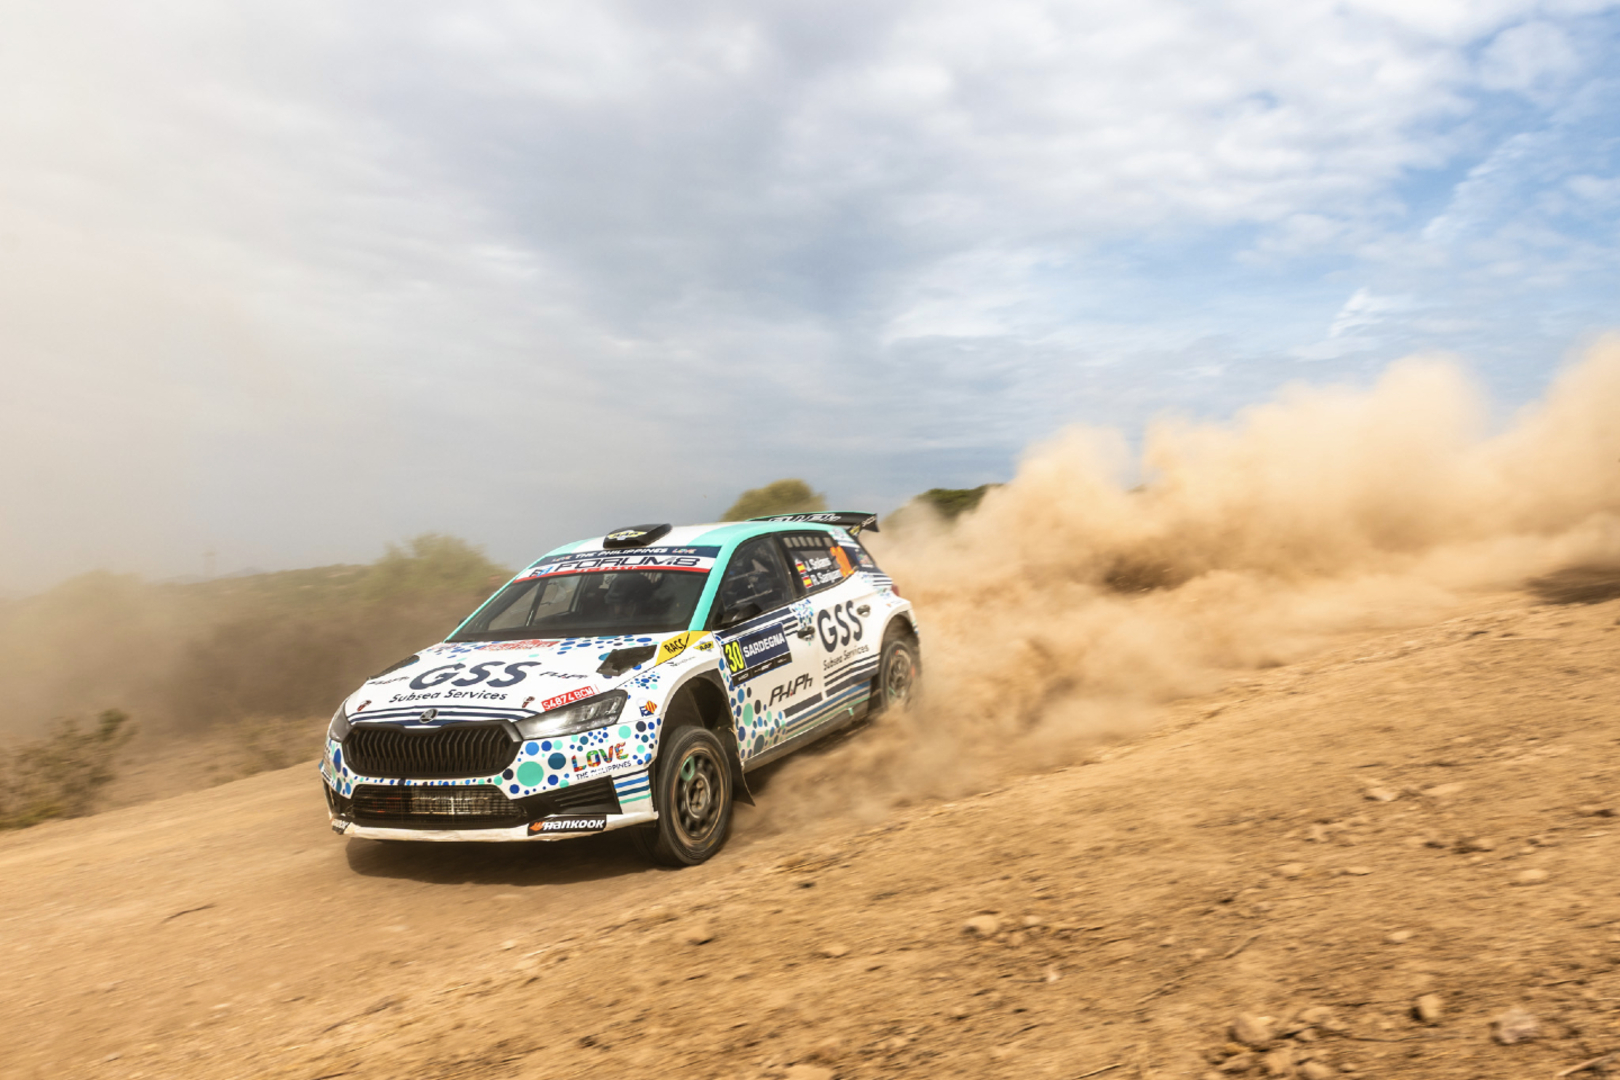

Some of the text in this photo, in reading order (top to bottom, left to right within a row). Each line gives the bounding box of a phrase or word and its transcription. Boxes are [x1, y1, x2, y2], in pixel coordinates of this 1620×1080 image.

[554, 556, 700, 572] FORUM8
[575, 547, 668, 560] THE PHILIPPINES
[817, 600, 863, 653] GSS
[664, 638, 687, 655] RACC
[725, 633, 786, 672] 30 SARDEGNA
[823, 644, 870, 671] Subsea Services
[409, 661, 542, 690] GSS
[388, 689, 508, 703] Subsea Services
[571, 741, 629, 773] LOVE
[576, 772, 589, 781] THE
